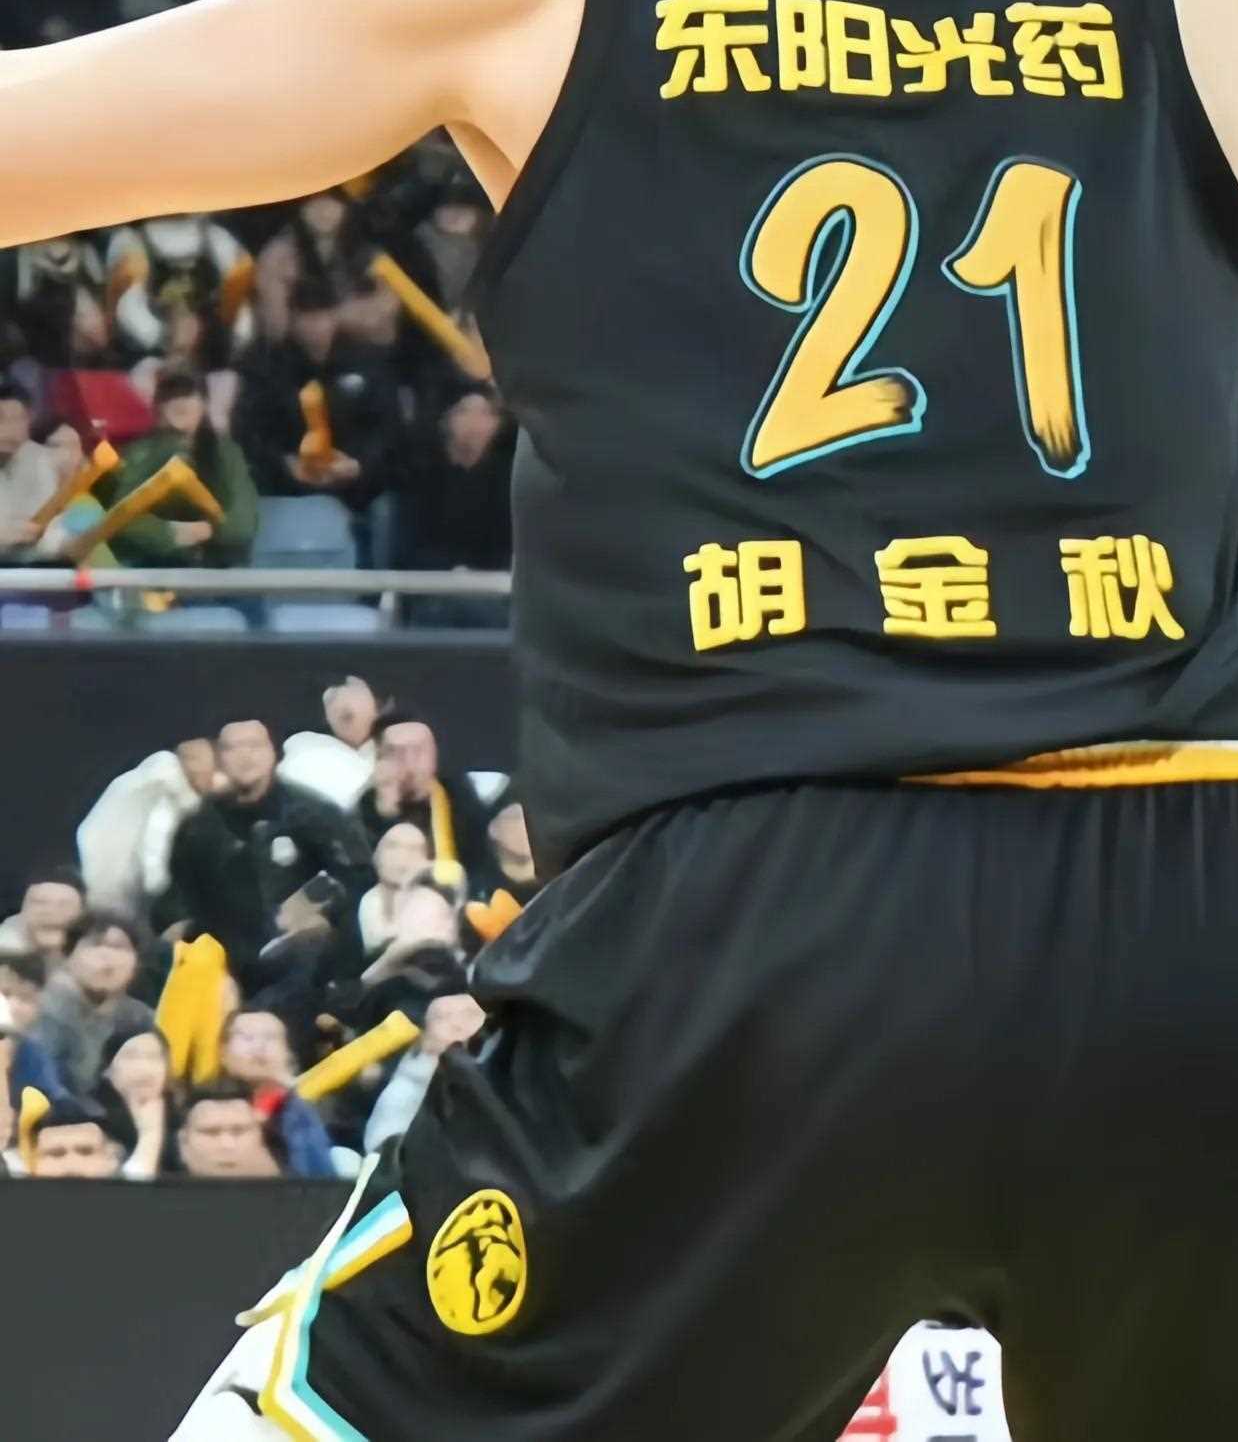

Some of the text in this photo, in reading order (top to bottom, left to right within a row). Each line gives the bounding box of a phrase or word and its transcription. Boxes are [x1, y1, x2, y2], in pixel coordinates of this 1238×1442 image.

[739, 152, 1091, 478] 21
[683, 534, 1185, 651] 胡金秋
